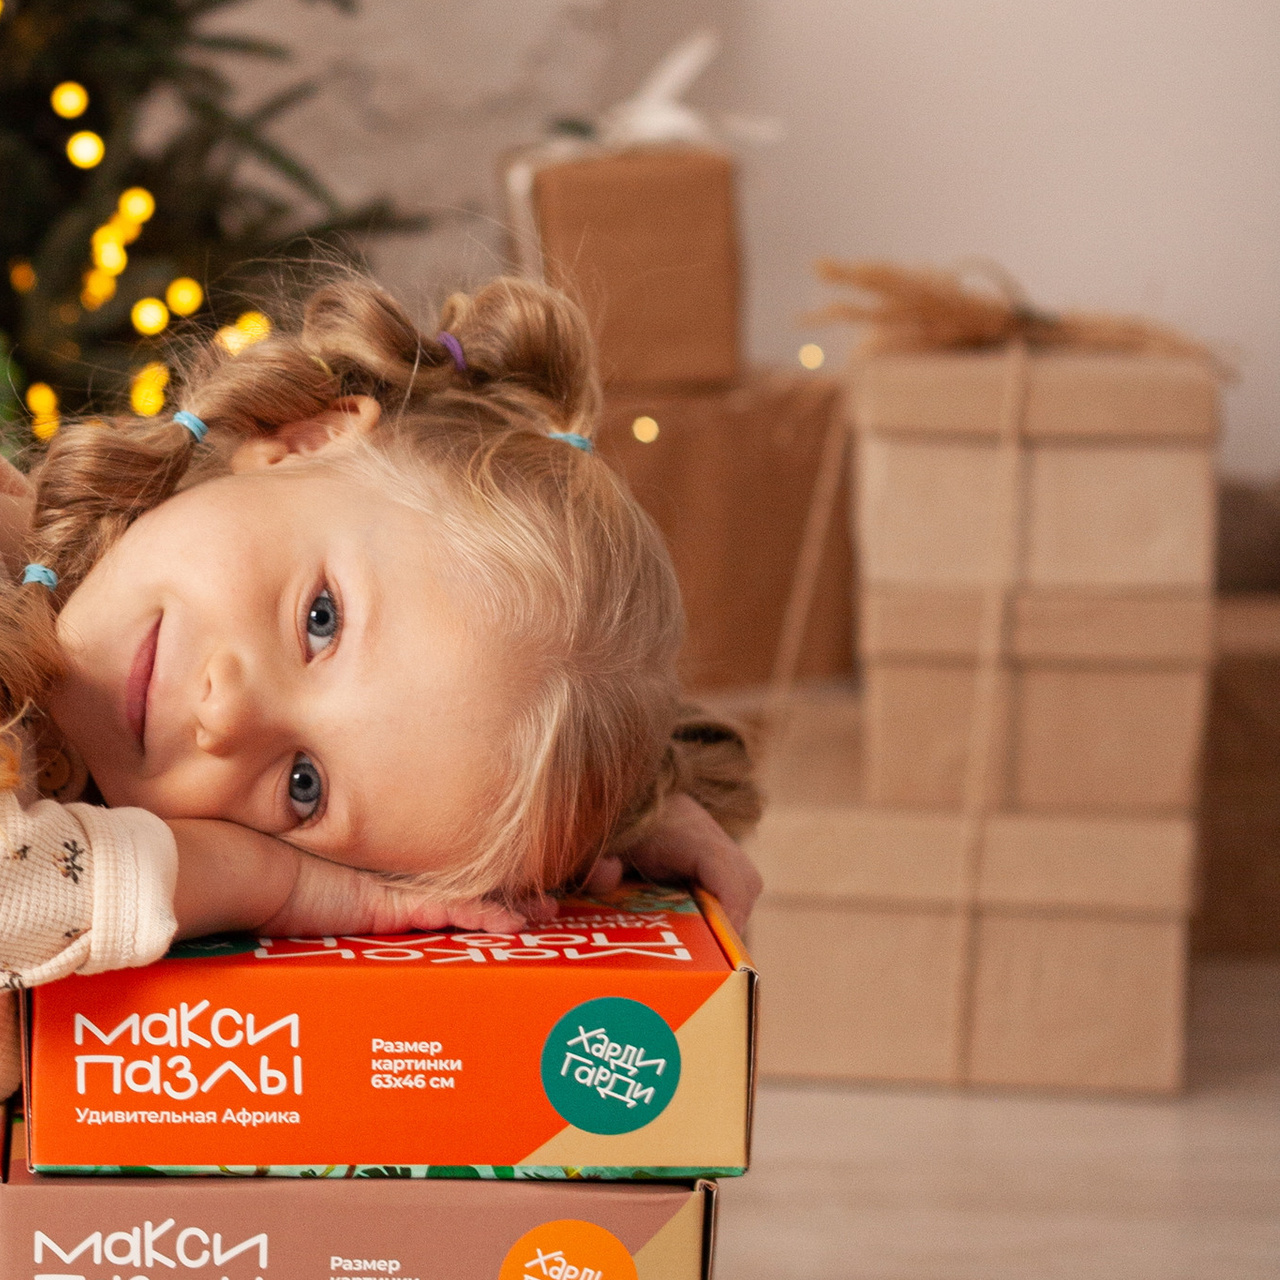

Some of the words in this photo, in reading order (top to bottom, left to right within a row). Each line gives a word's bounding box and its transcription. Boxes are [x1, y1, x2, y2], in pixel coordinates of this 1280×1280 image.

[371, 1038, 443, 1057] Размер
[371, 1058, 463, 1074] картинки
[429, 1076, 455, 1089] см
[75, 1107, 217, 1125] Удивительная
[221, 1107, 300, 1127] Африка
[330, 1256, 401, 1275] Размер
